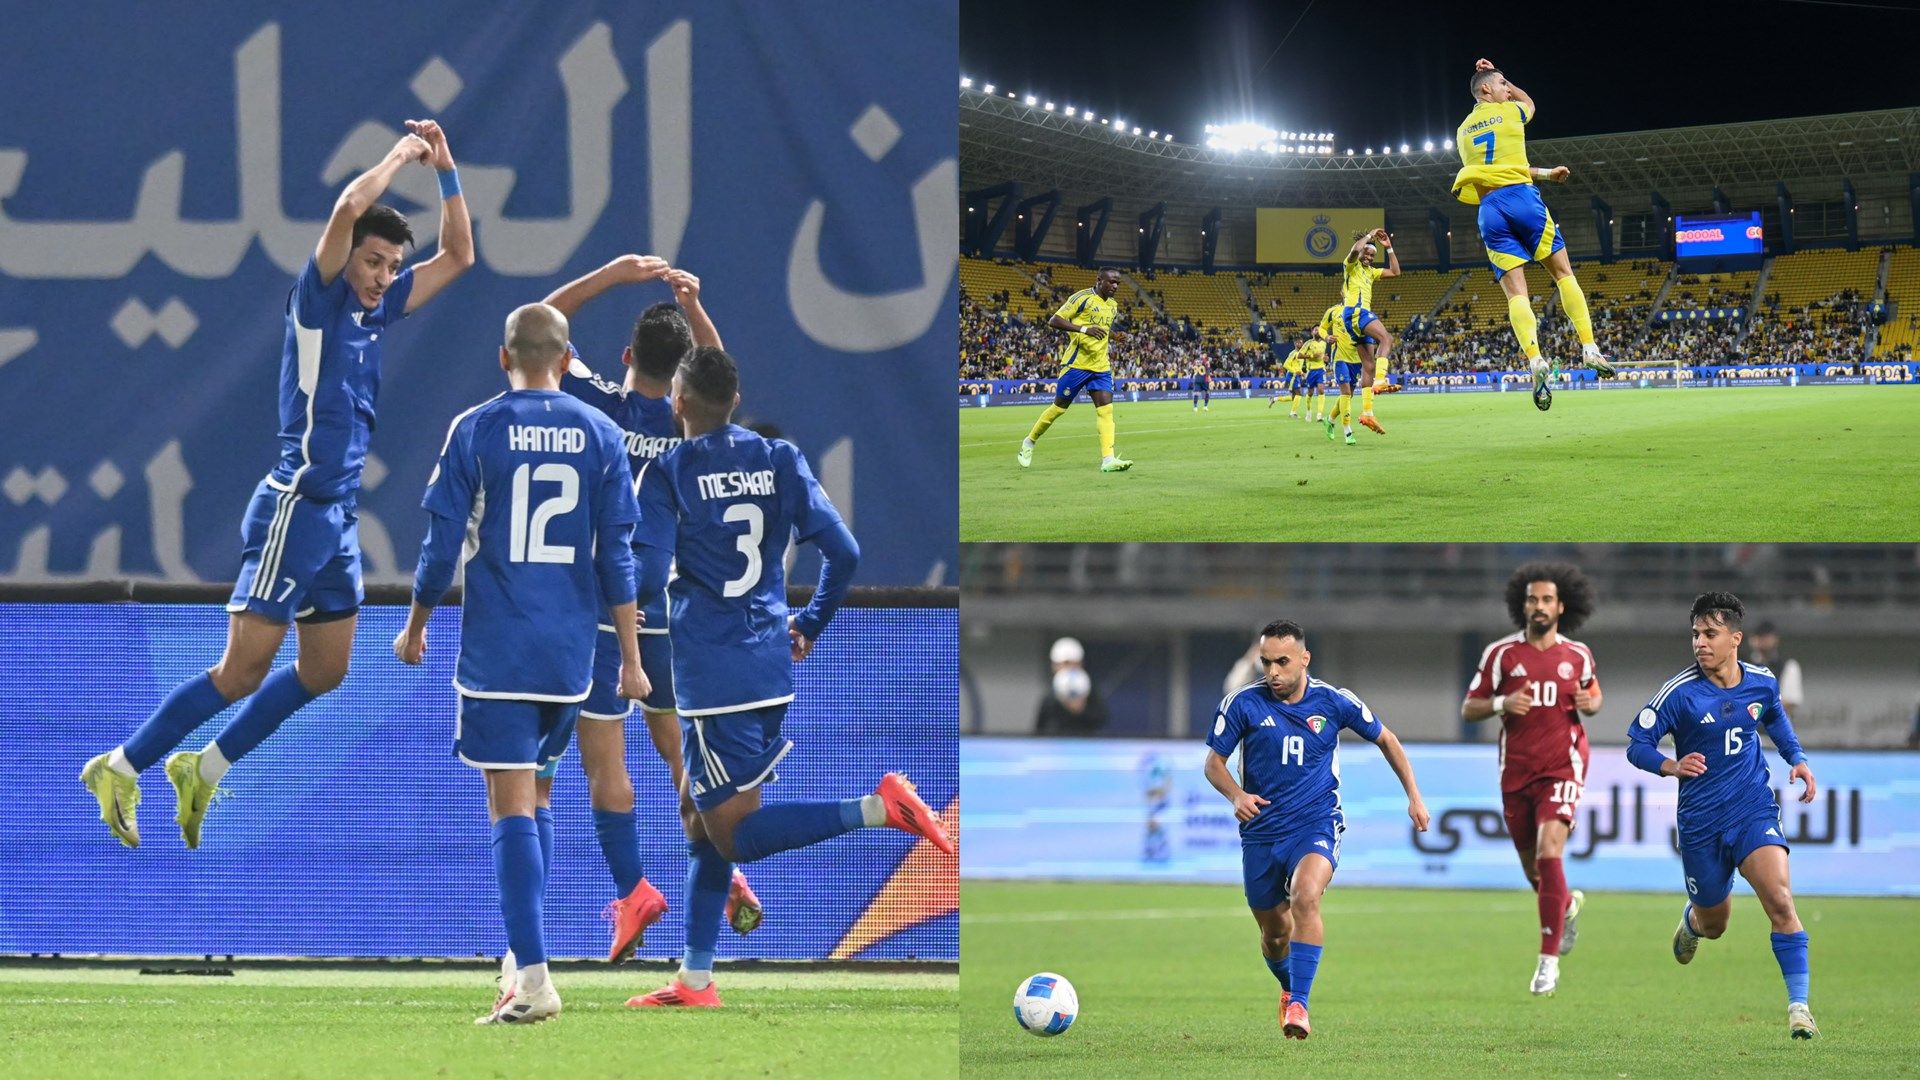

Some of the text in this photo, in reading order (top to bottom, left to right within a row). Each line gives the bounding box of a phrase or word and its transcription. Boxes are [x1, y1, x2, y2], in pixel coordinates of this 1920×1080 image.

[1473, 130, 1496, 165] 7
[0, 19, 692, 368] الخلي
[508, 425, 586, 453] HAMAD
[510, 463, 580, 564] 12
[723, 503, 764, 597] 3
[277, 577, 296, 602] 7
[1529, 681, 1558, 707] 10
[1281, 735, 1305, 766] 19
[1724, 727, 1743, 756] 15
[1550, 780, 1579, 803] 10
